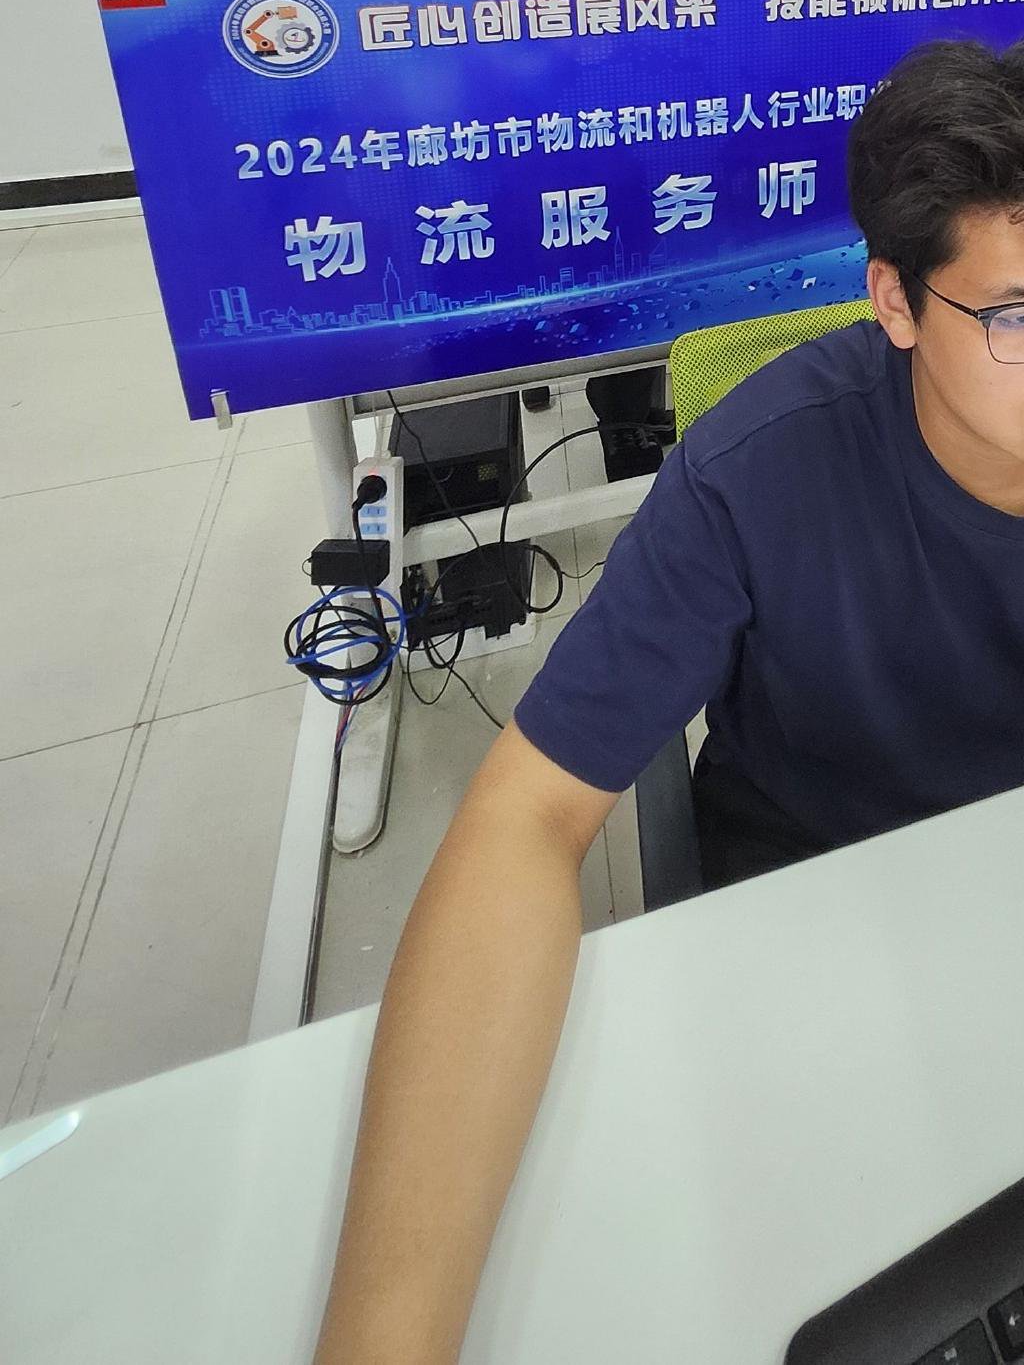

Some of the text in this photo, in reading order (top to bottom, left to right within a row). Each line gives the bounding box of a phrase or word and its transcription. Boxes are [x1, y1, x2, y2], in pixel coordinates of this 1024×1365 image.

[283, 159, 818, 284] 物流服务师
